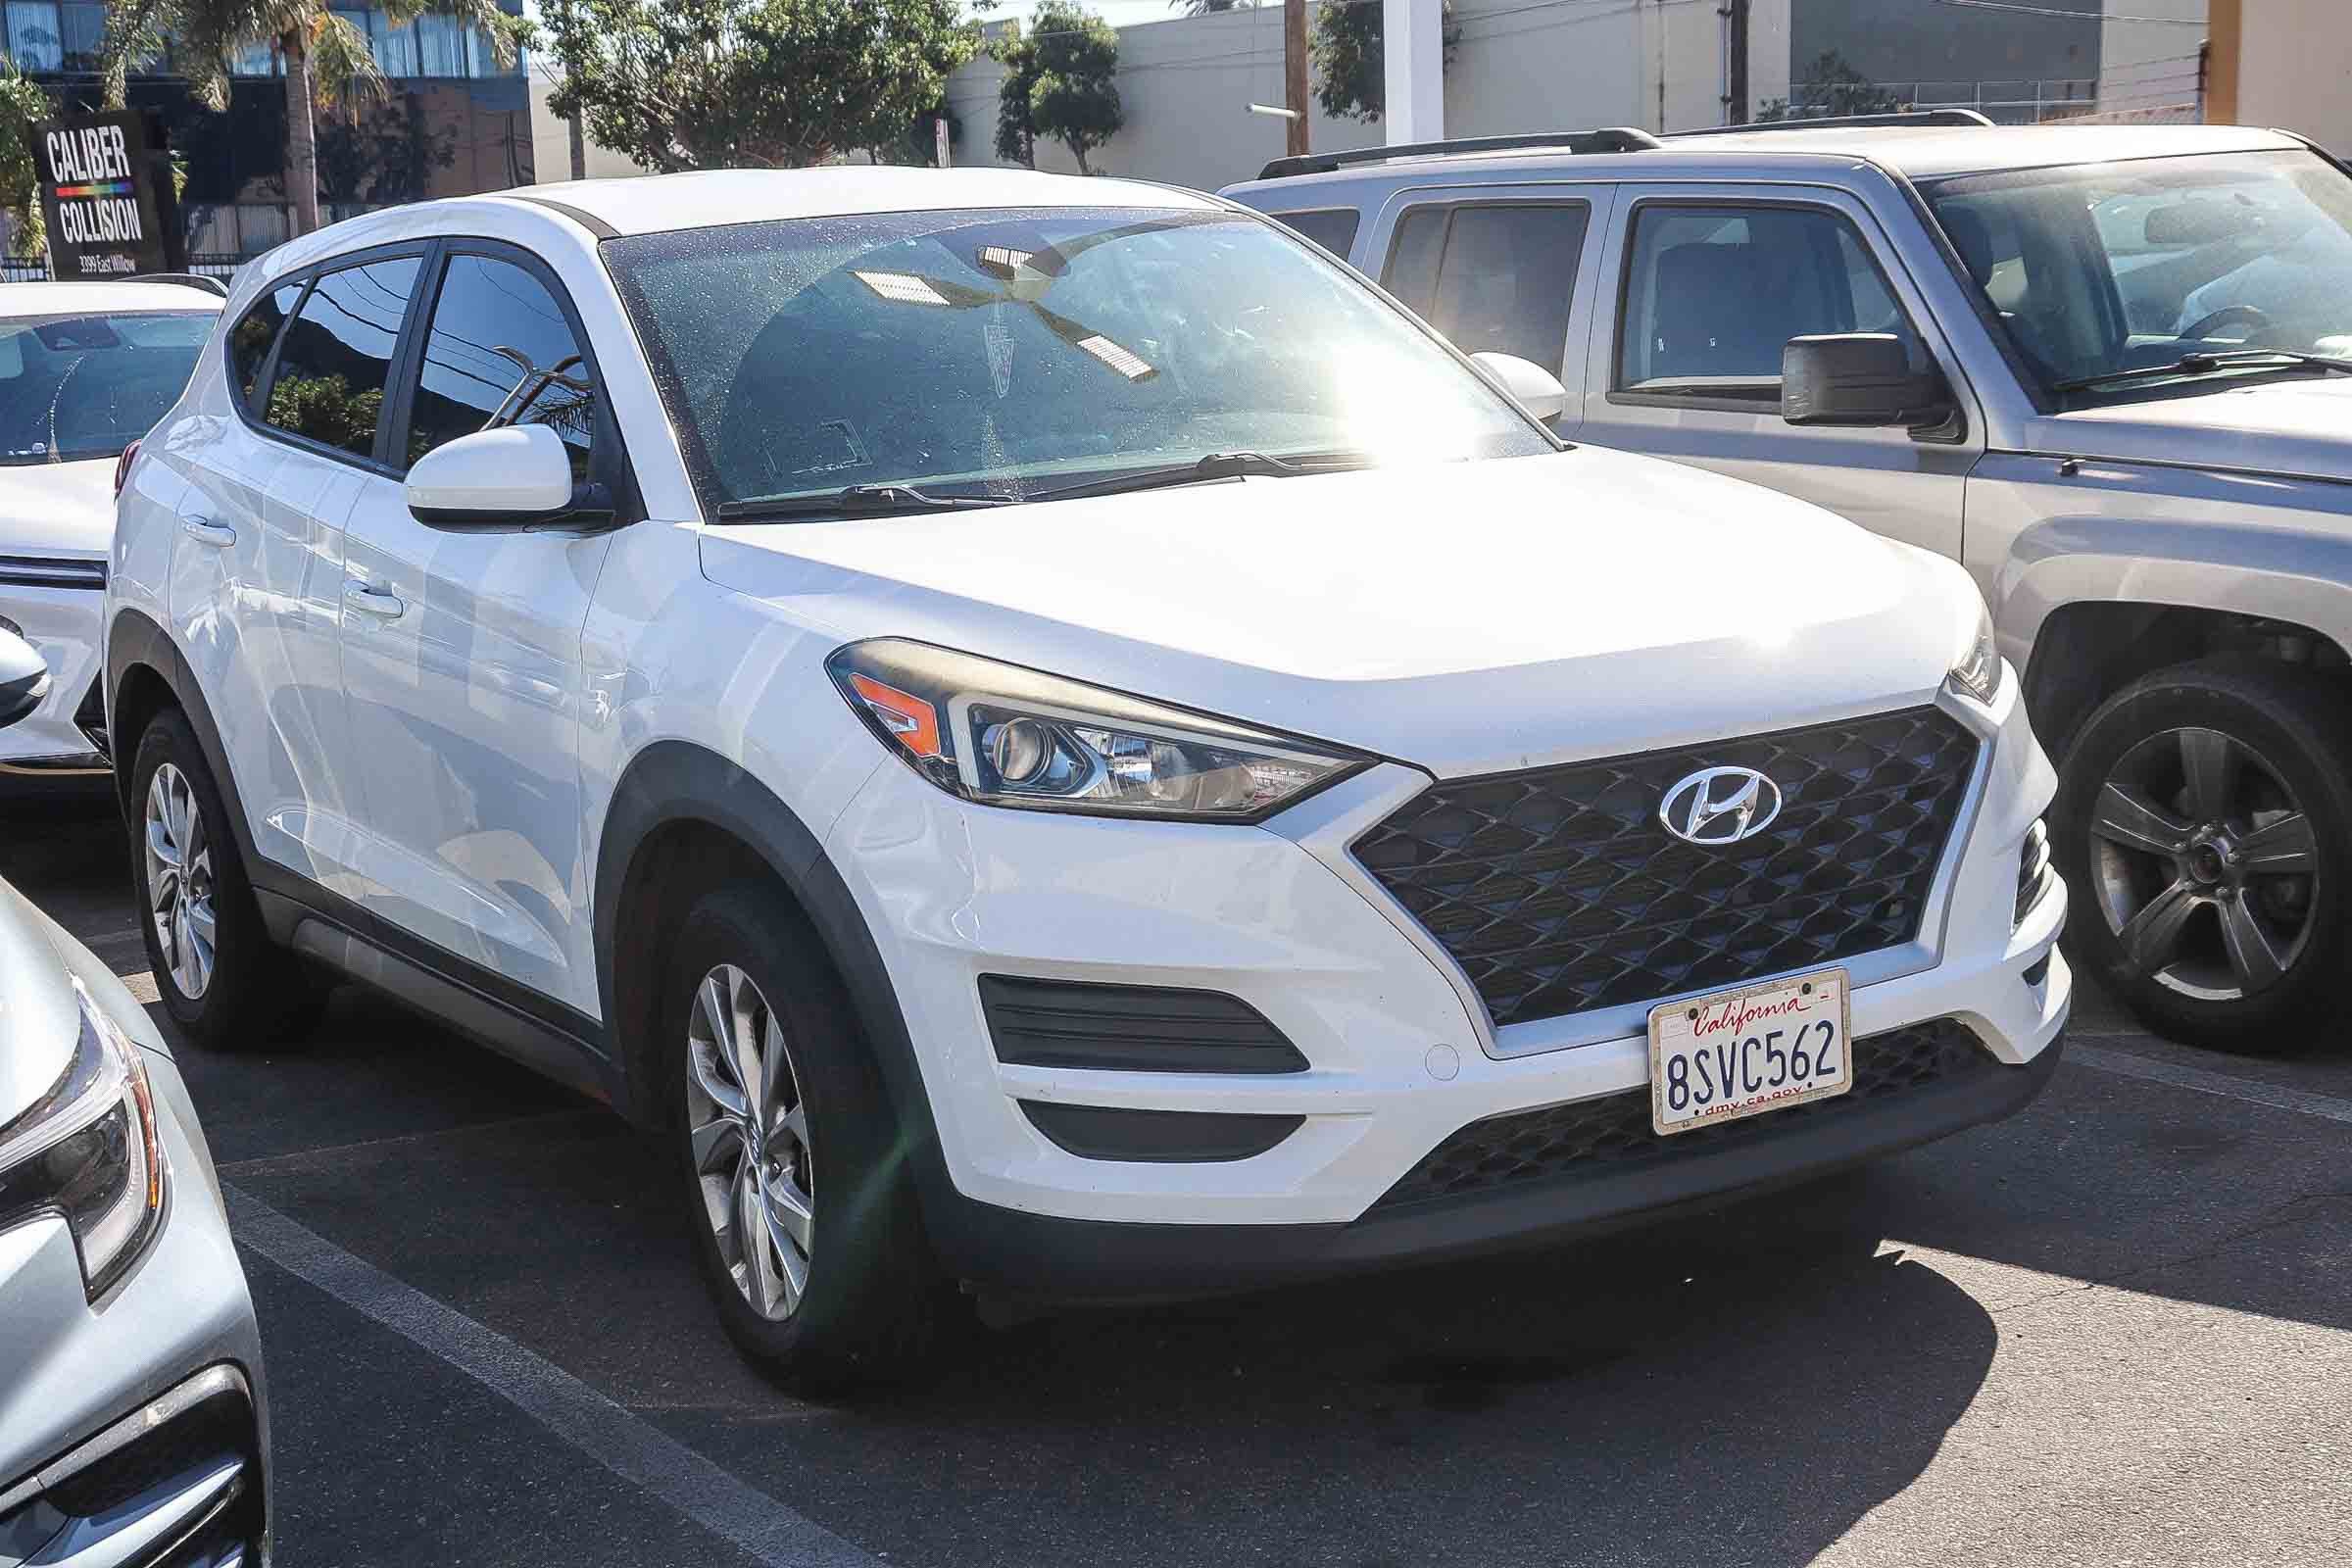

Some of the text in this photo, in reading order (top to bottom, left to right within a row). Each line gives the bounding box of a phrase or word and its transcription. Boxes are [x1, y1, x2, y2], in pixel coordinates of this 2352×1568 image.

[47, 124, 131, 182] CALIBER
[60, 198, 142, 243] COLLISION
[78, 253, 136, 273] 3399 East Willow
[1692, 997, 1812, 1038] California
[1667, 1019, 1837, 1111] 8SVC562
[1705, 1085, 1804, 1117] dmv.ca.gov
